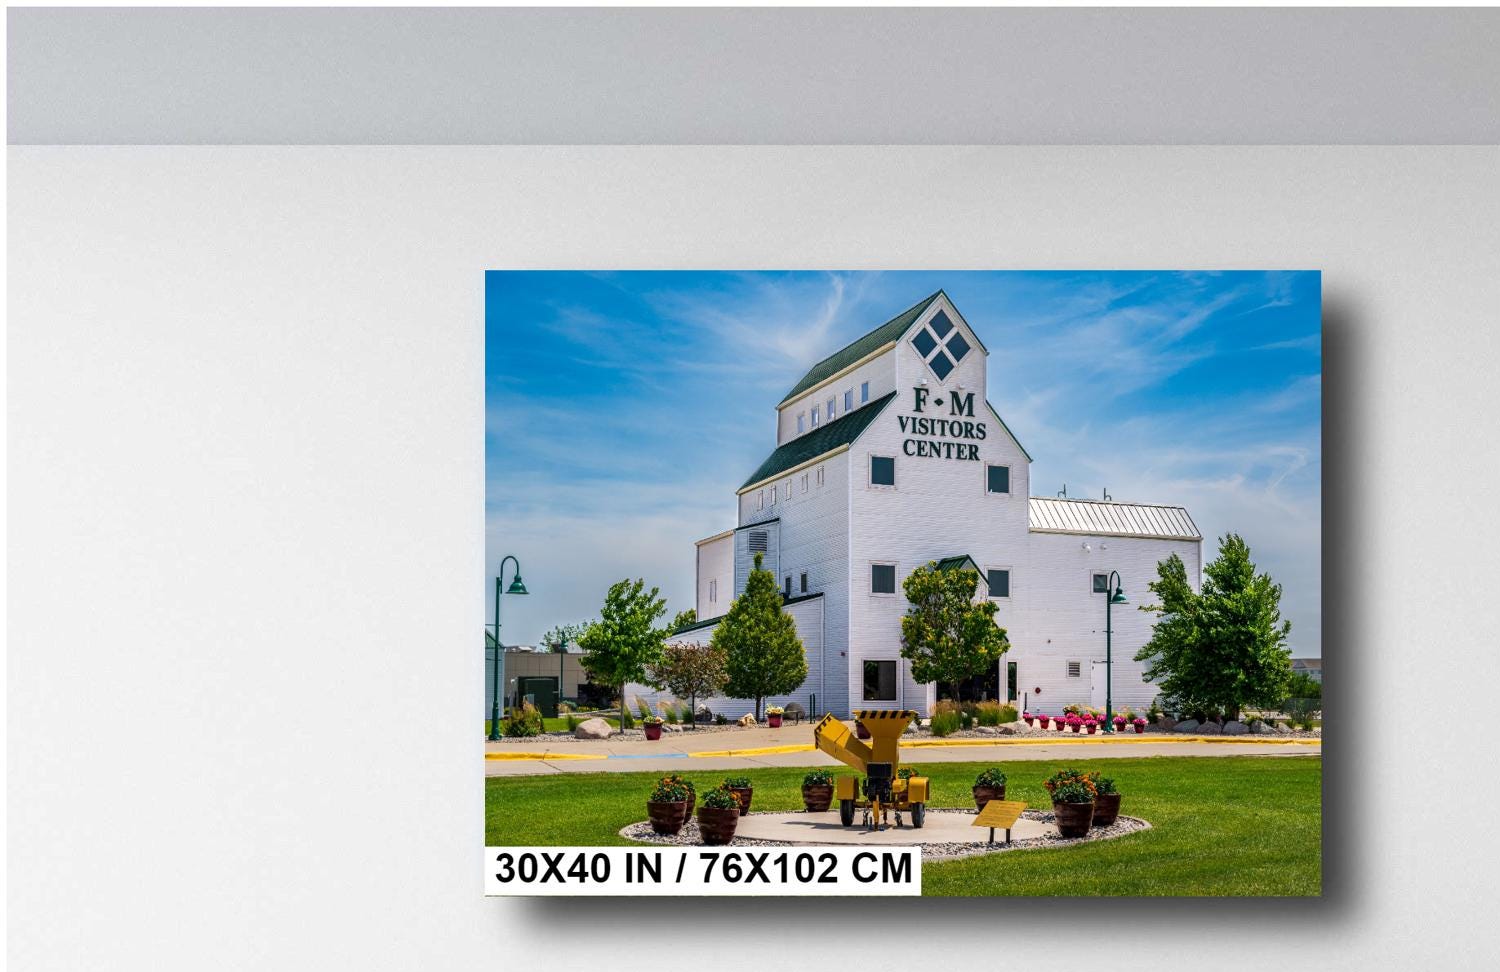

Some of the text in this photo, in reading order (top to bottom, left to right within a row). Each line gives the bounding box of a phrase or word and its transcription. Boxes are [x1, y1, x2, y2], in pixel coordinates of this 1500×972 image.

[912, 386, 976, 418] F M
[897, 415, 987, 441] VISITORS
[902, 439, 981, 462] CENTER
